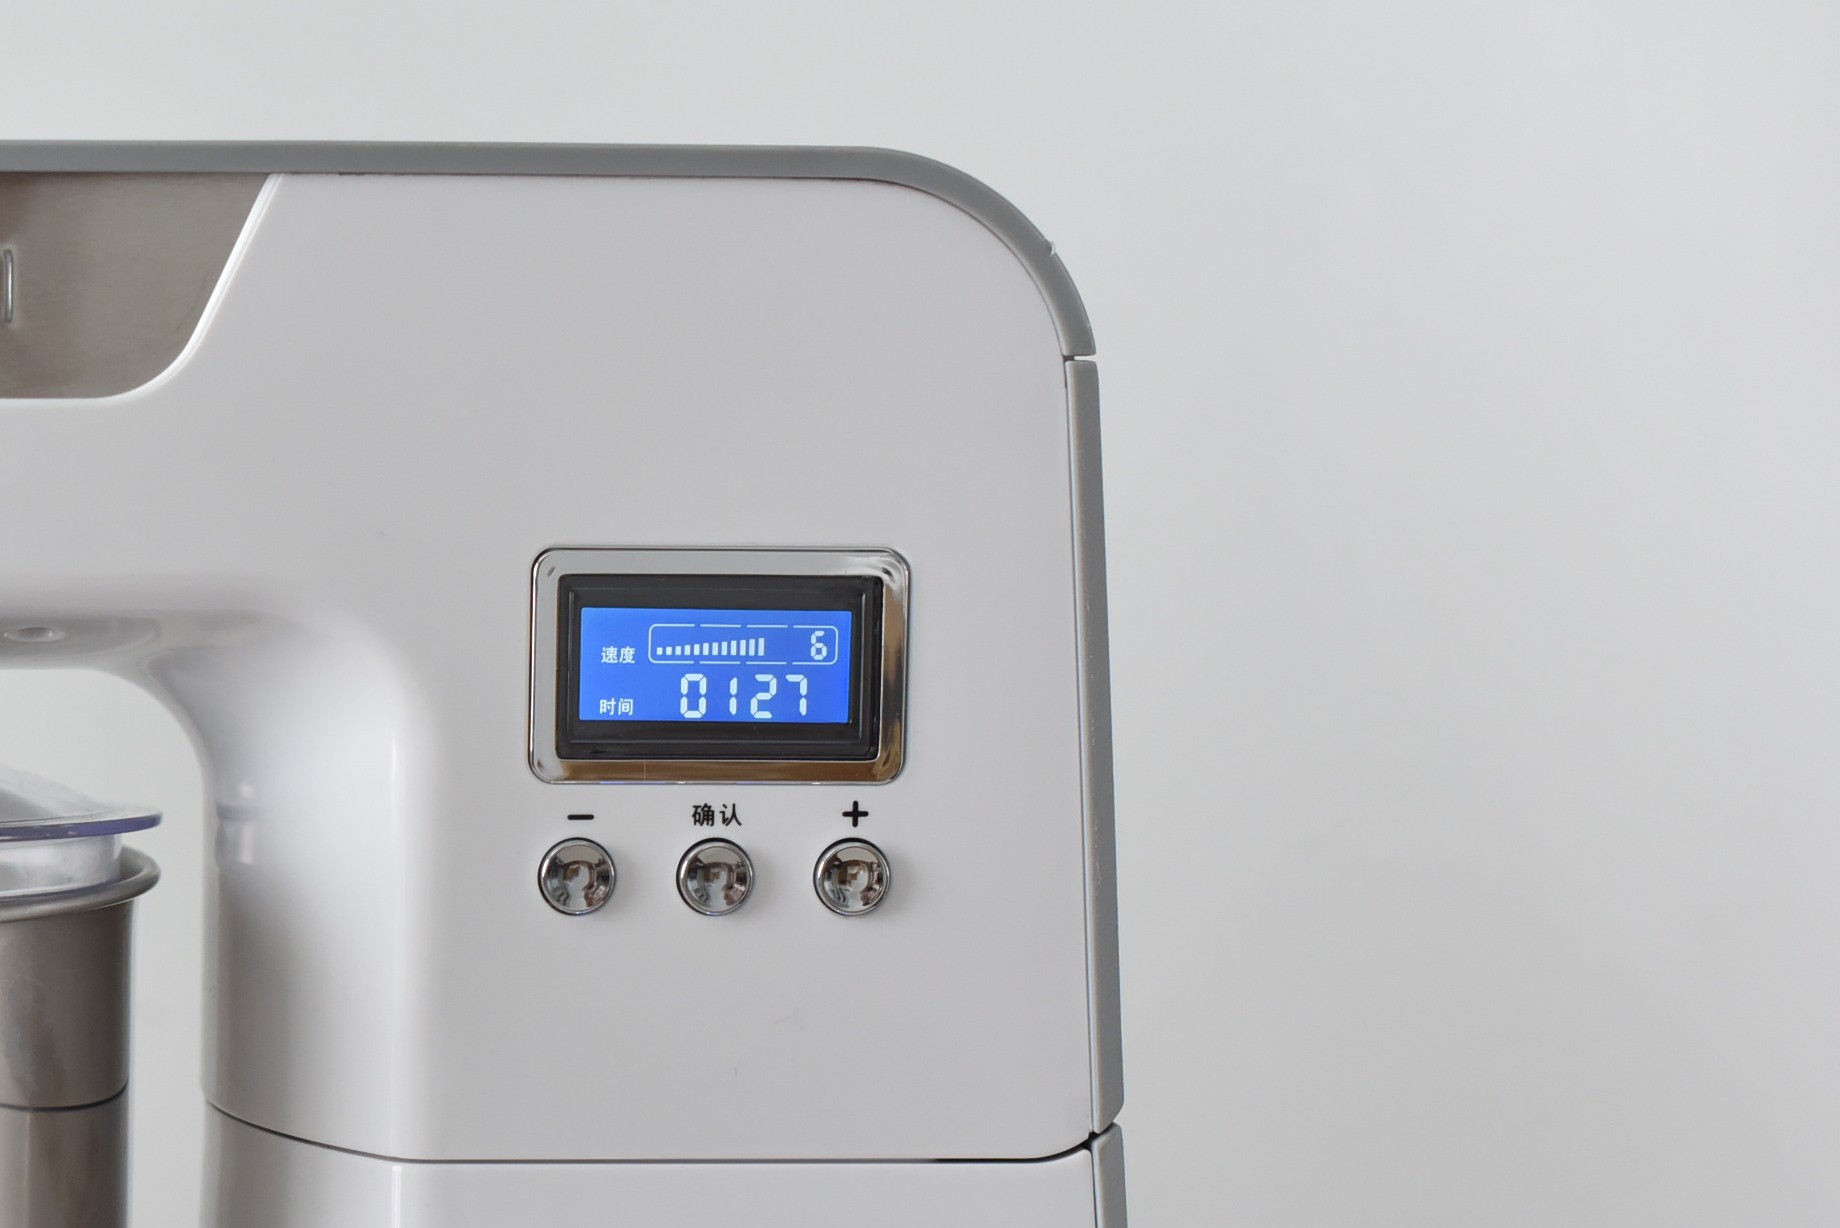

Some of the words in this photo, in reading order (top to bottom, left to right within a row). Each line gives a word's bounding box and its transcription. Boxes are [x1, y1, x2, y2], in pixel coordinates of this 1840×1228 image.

[601, 645, 636, 664] 速度
[810, 630, 828, 661] 6
[599, 697, 634, 716] 时间
[680, 673, 808, 719] 0127
[691, 802, 742, 827] 确认
